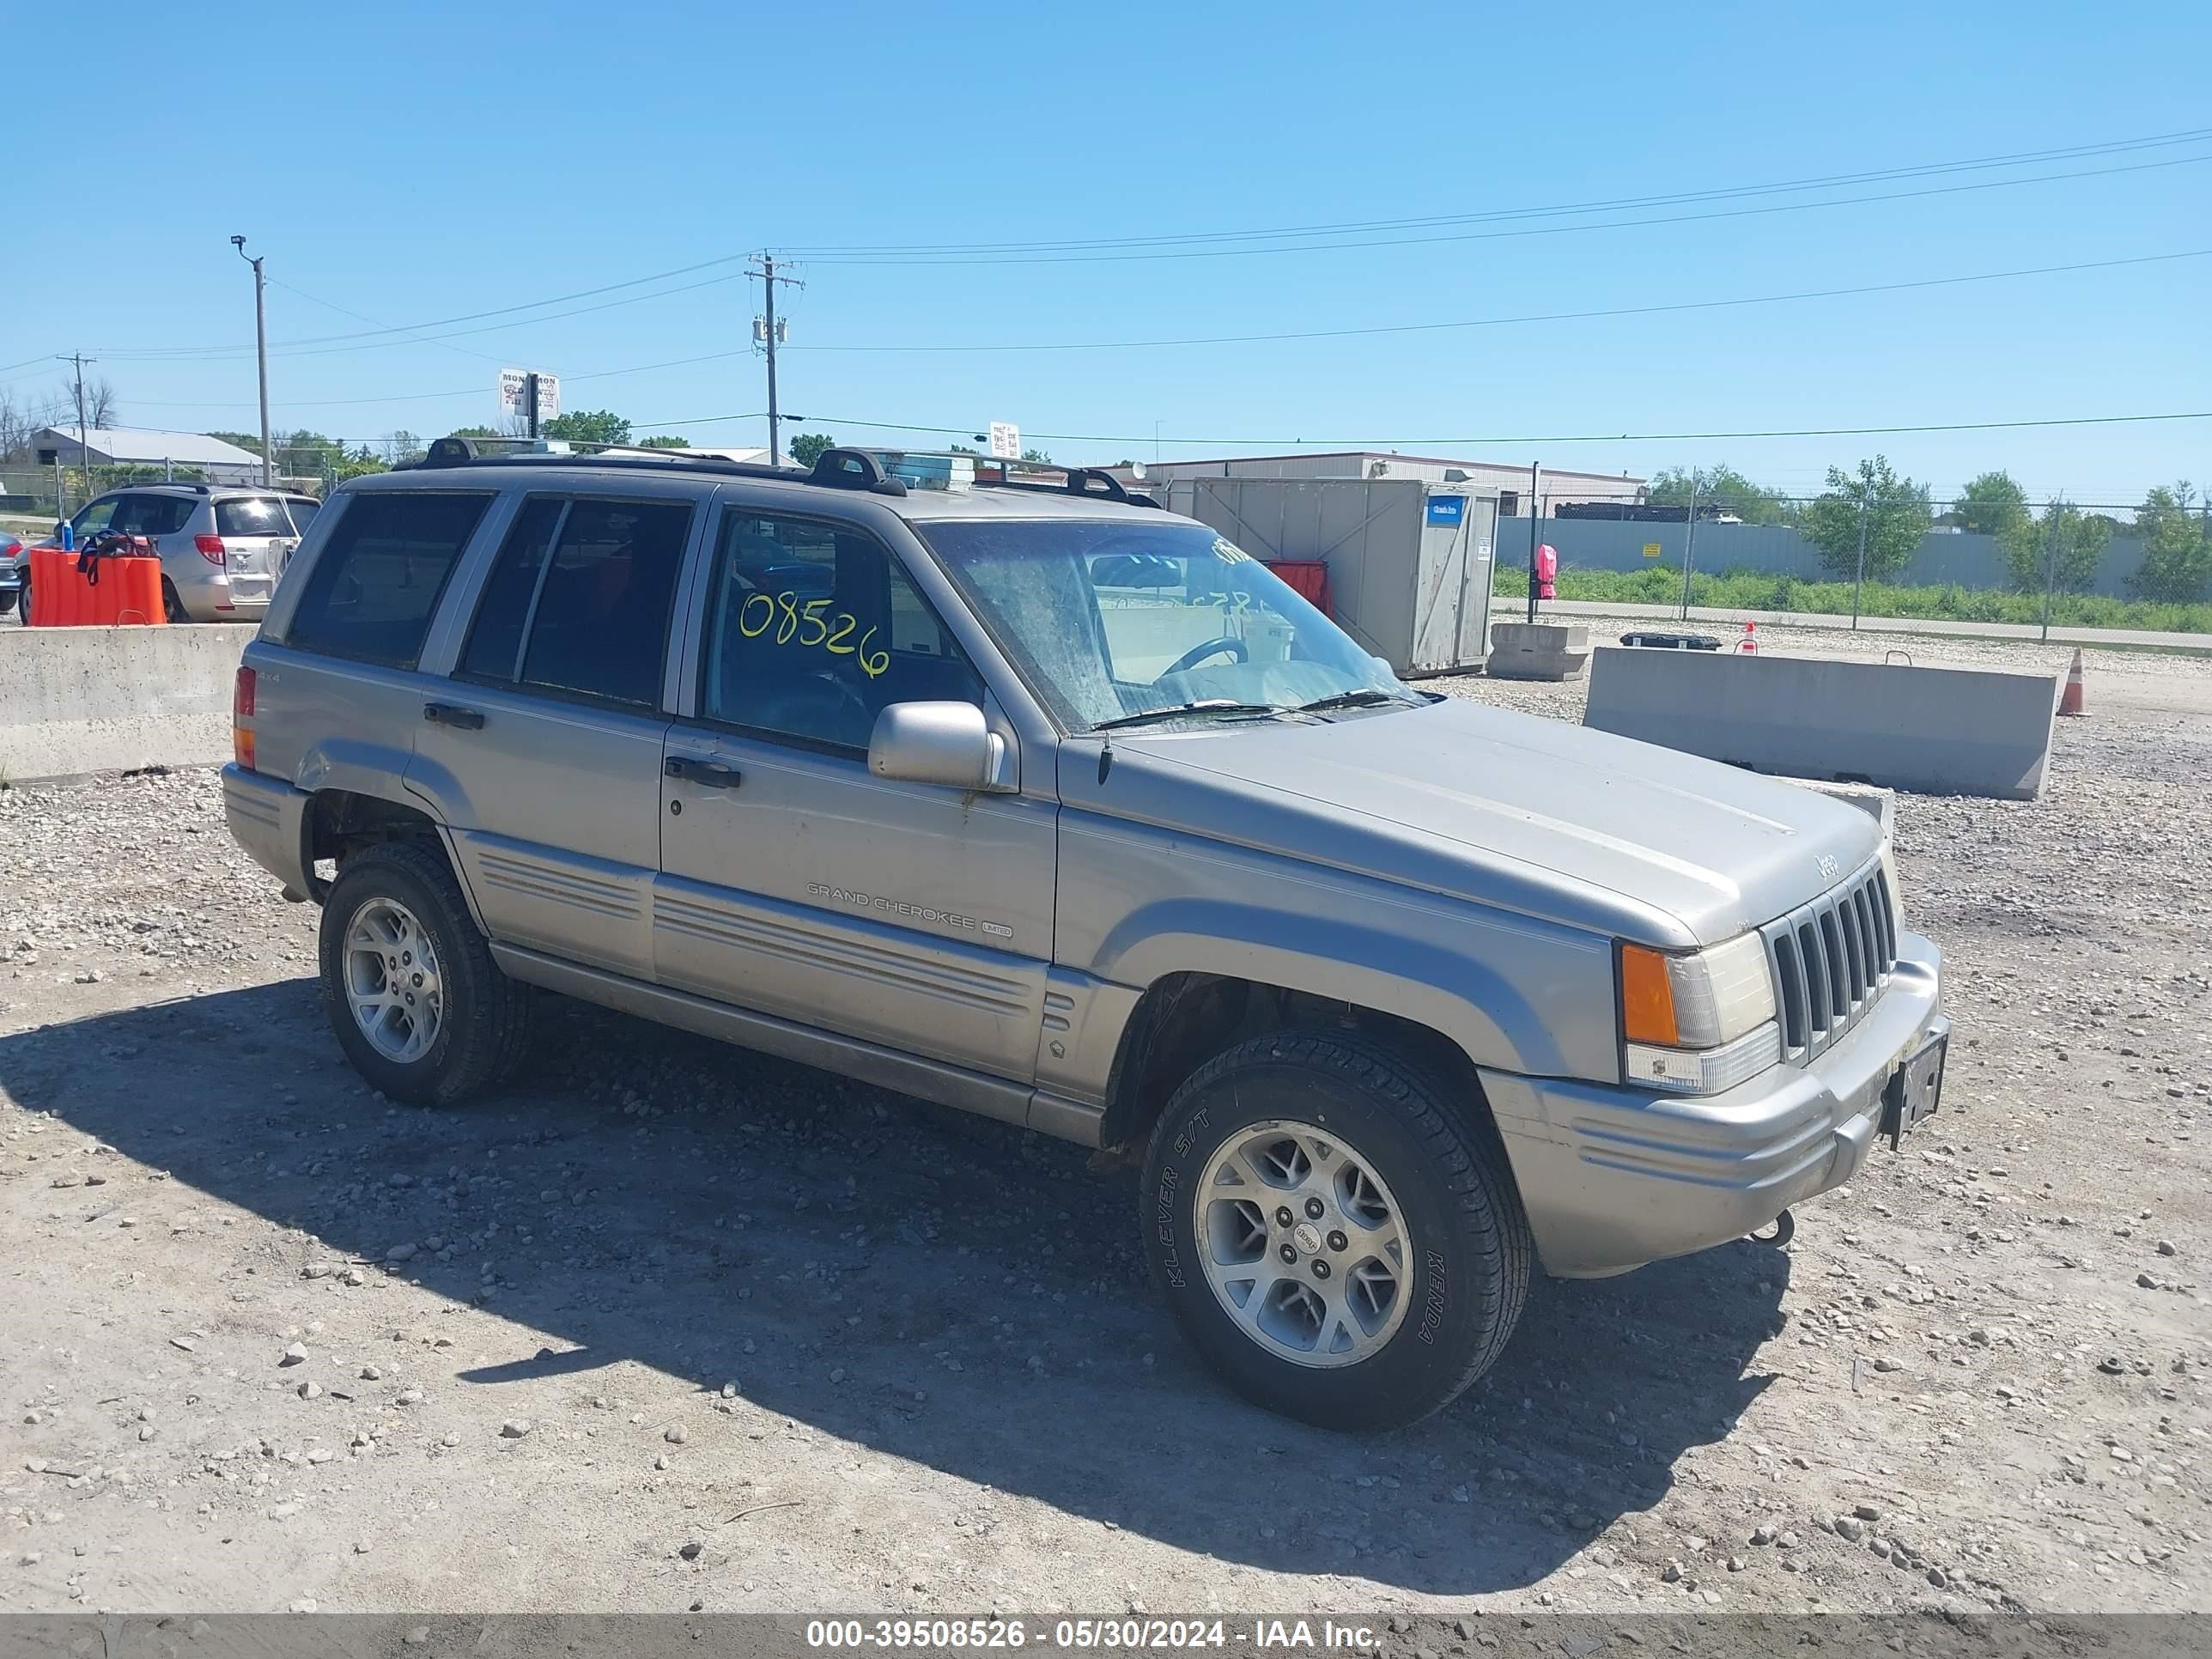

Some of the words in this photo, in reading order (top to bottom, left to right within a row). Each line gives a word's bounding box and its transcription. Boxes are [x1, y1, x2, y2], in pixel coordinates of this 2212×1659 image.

[739, 591, 890, 680] 08526
[806, 882, 869, 906] GRAND
[874, 897, 976, 930] CHEROKEE
[983, 923, 1012, 937] LIMITED
[1158, 1165, 1187, 1288] KLEVER
[1174, 1108, 1210, 1158] S/T
[1296, 1228, 1318, 1249] Jeep
[1418, 1249, 1445, 1345] KENDA
